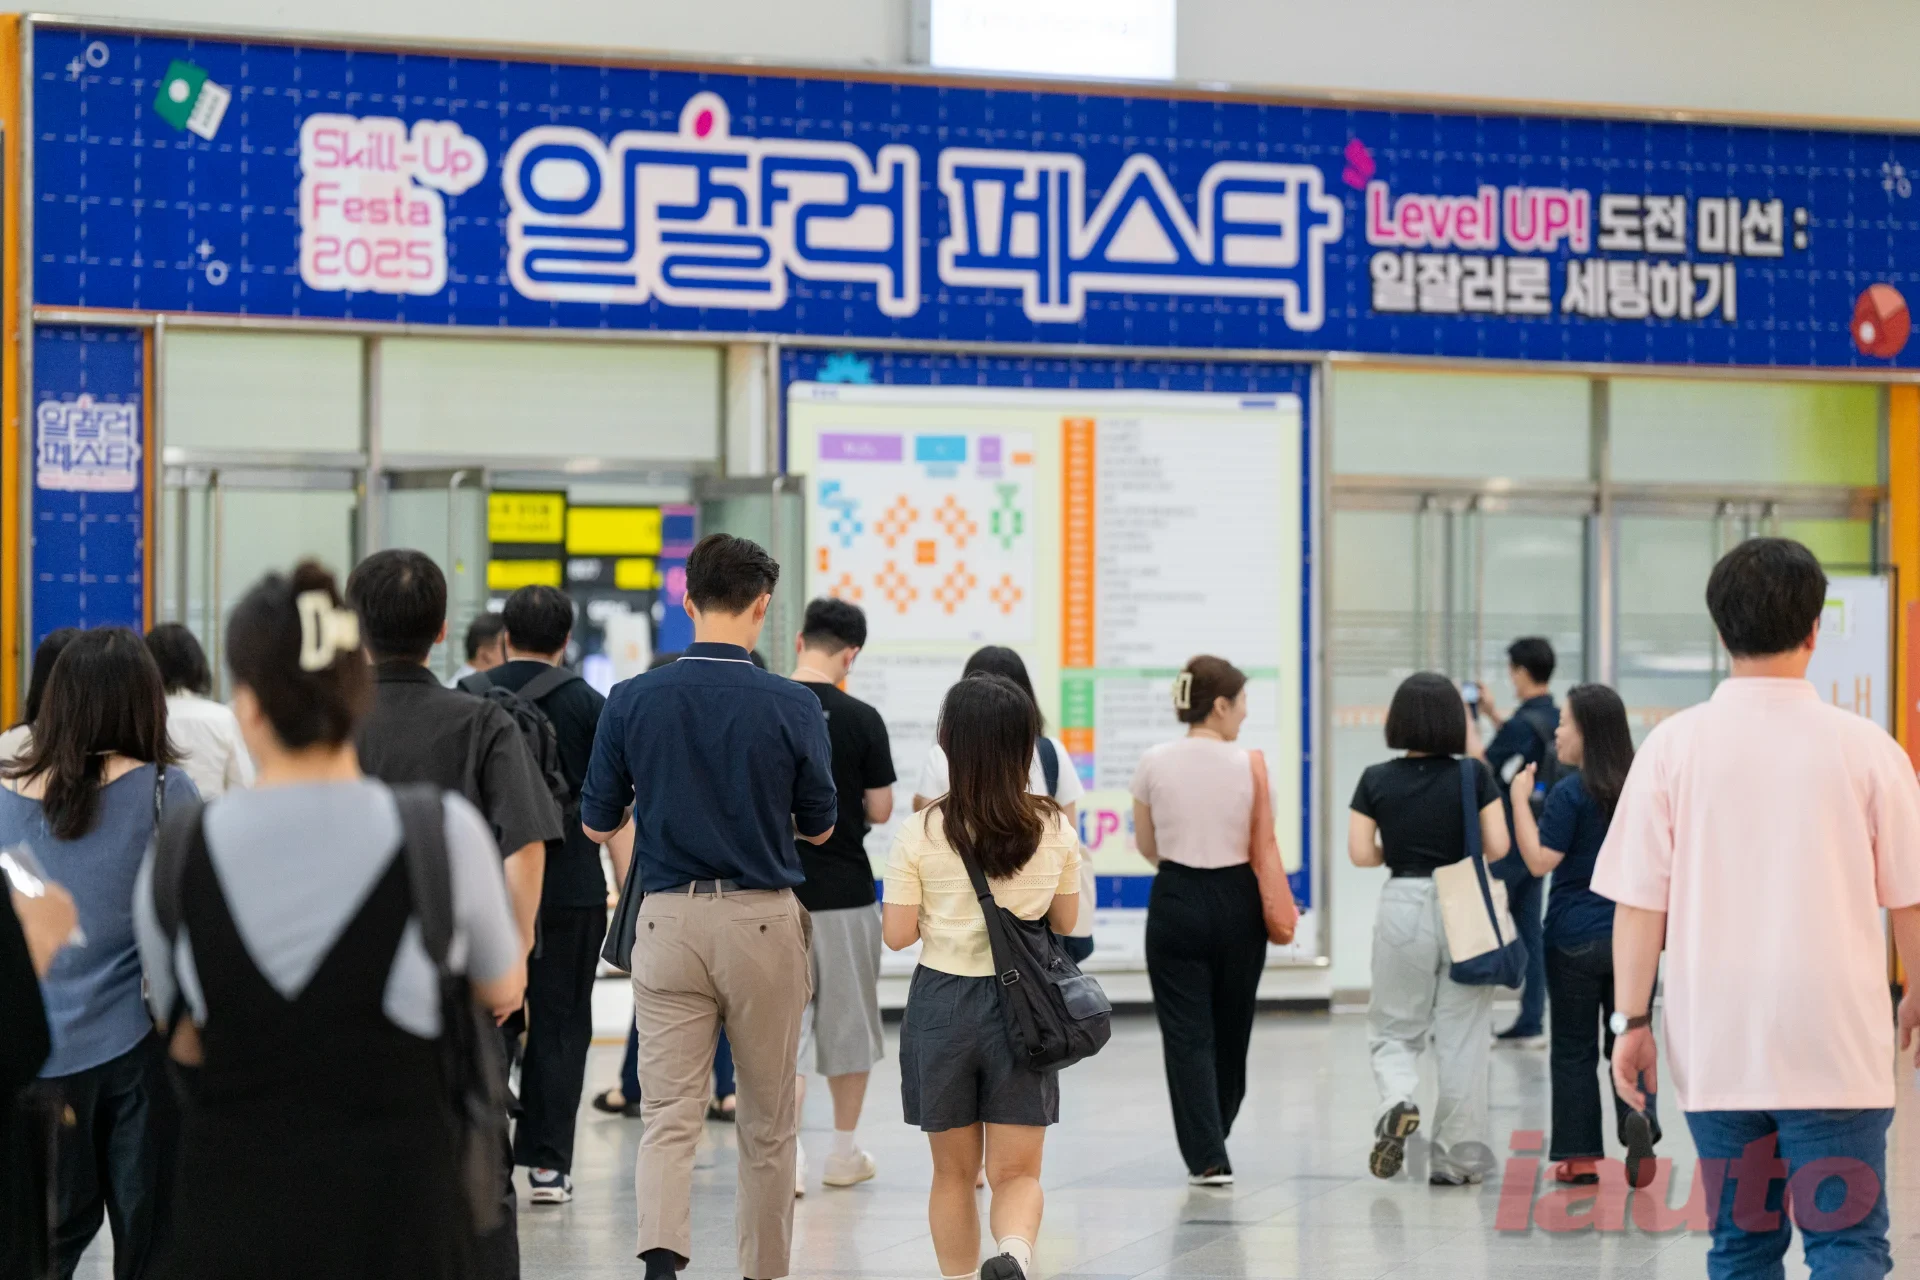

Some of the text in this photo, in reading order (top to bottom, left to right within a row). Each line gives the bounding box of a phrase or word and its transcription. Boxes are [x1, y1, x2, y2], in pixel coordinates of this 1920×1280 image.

[312, 127, 474, 181] Skill-Up
[312, 182, 431, 226] Festa
[512, 100, 1335, 322] 일잘러 페스타
[1369, 185, 1495, 245] Level
[1508, 190, 1588, 248] UP!
[1597, 193, 1688, 255] 도전
[1696, 197, 1785, 258] 미션
[312, 235, 434, 280] 2025
[1369, 250, 1738, 323] 일잘러로 세팅하기
